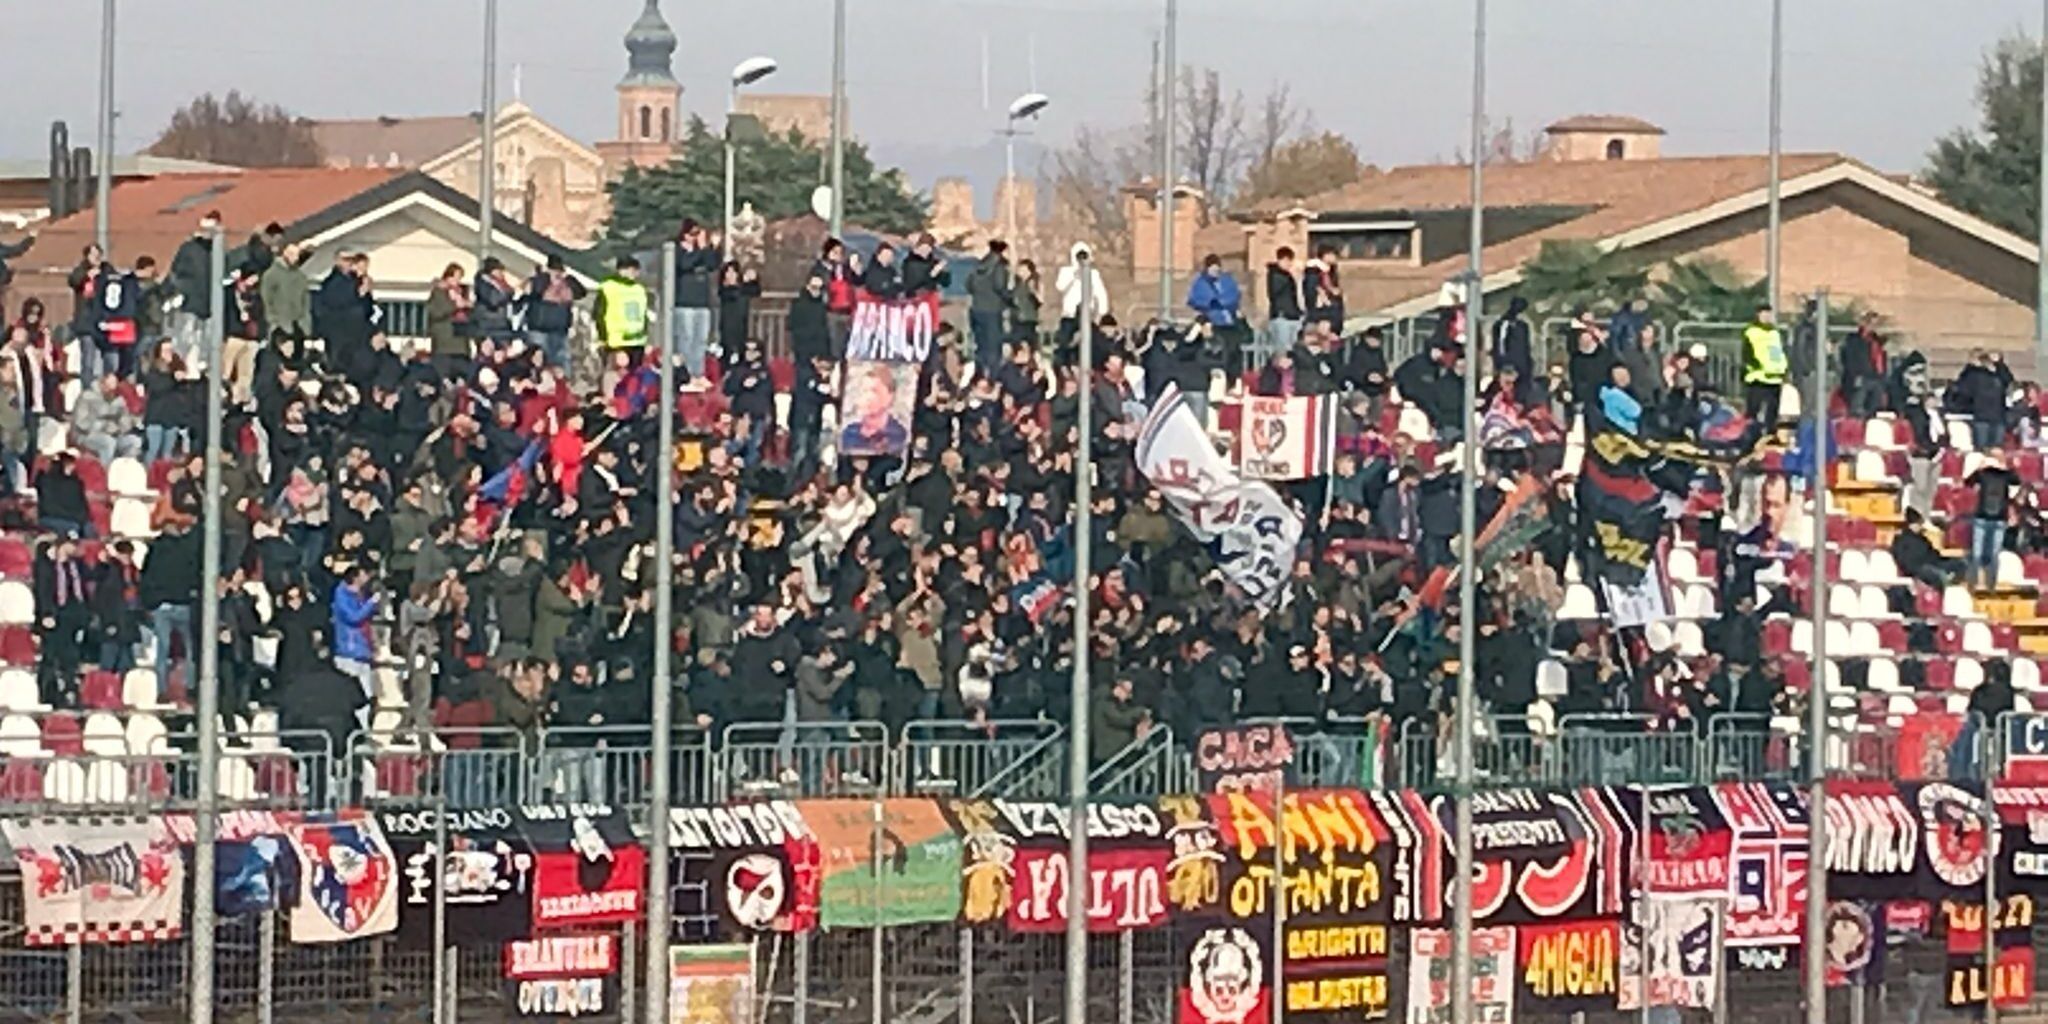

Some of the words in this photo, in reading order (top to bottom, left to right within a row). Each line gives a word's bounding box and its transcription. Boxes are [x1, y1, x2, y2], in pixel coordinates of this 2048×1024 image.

[1226, 792, 1377, 863] ANNI
[1231, 861, 1380, 920] OTTANTA
[1287, 925, 1386, 959] BRIGATA
